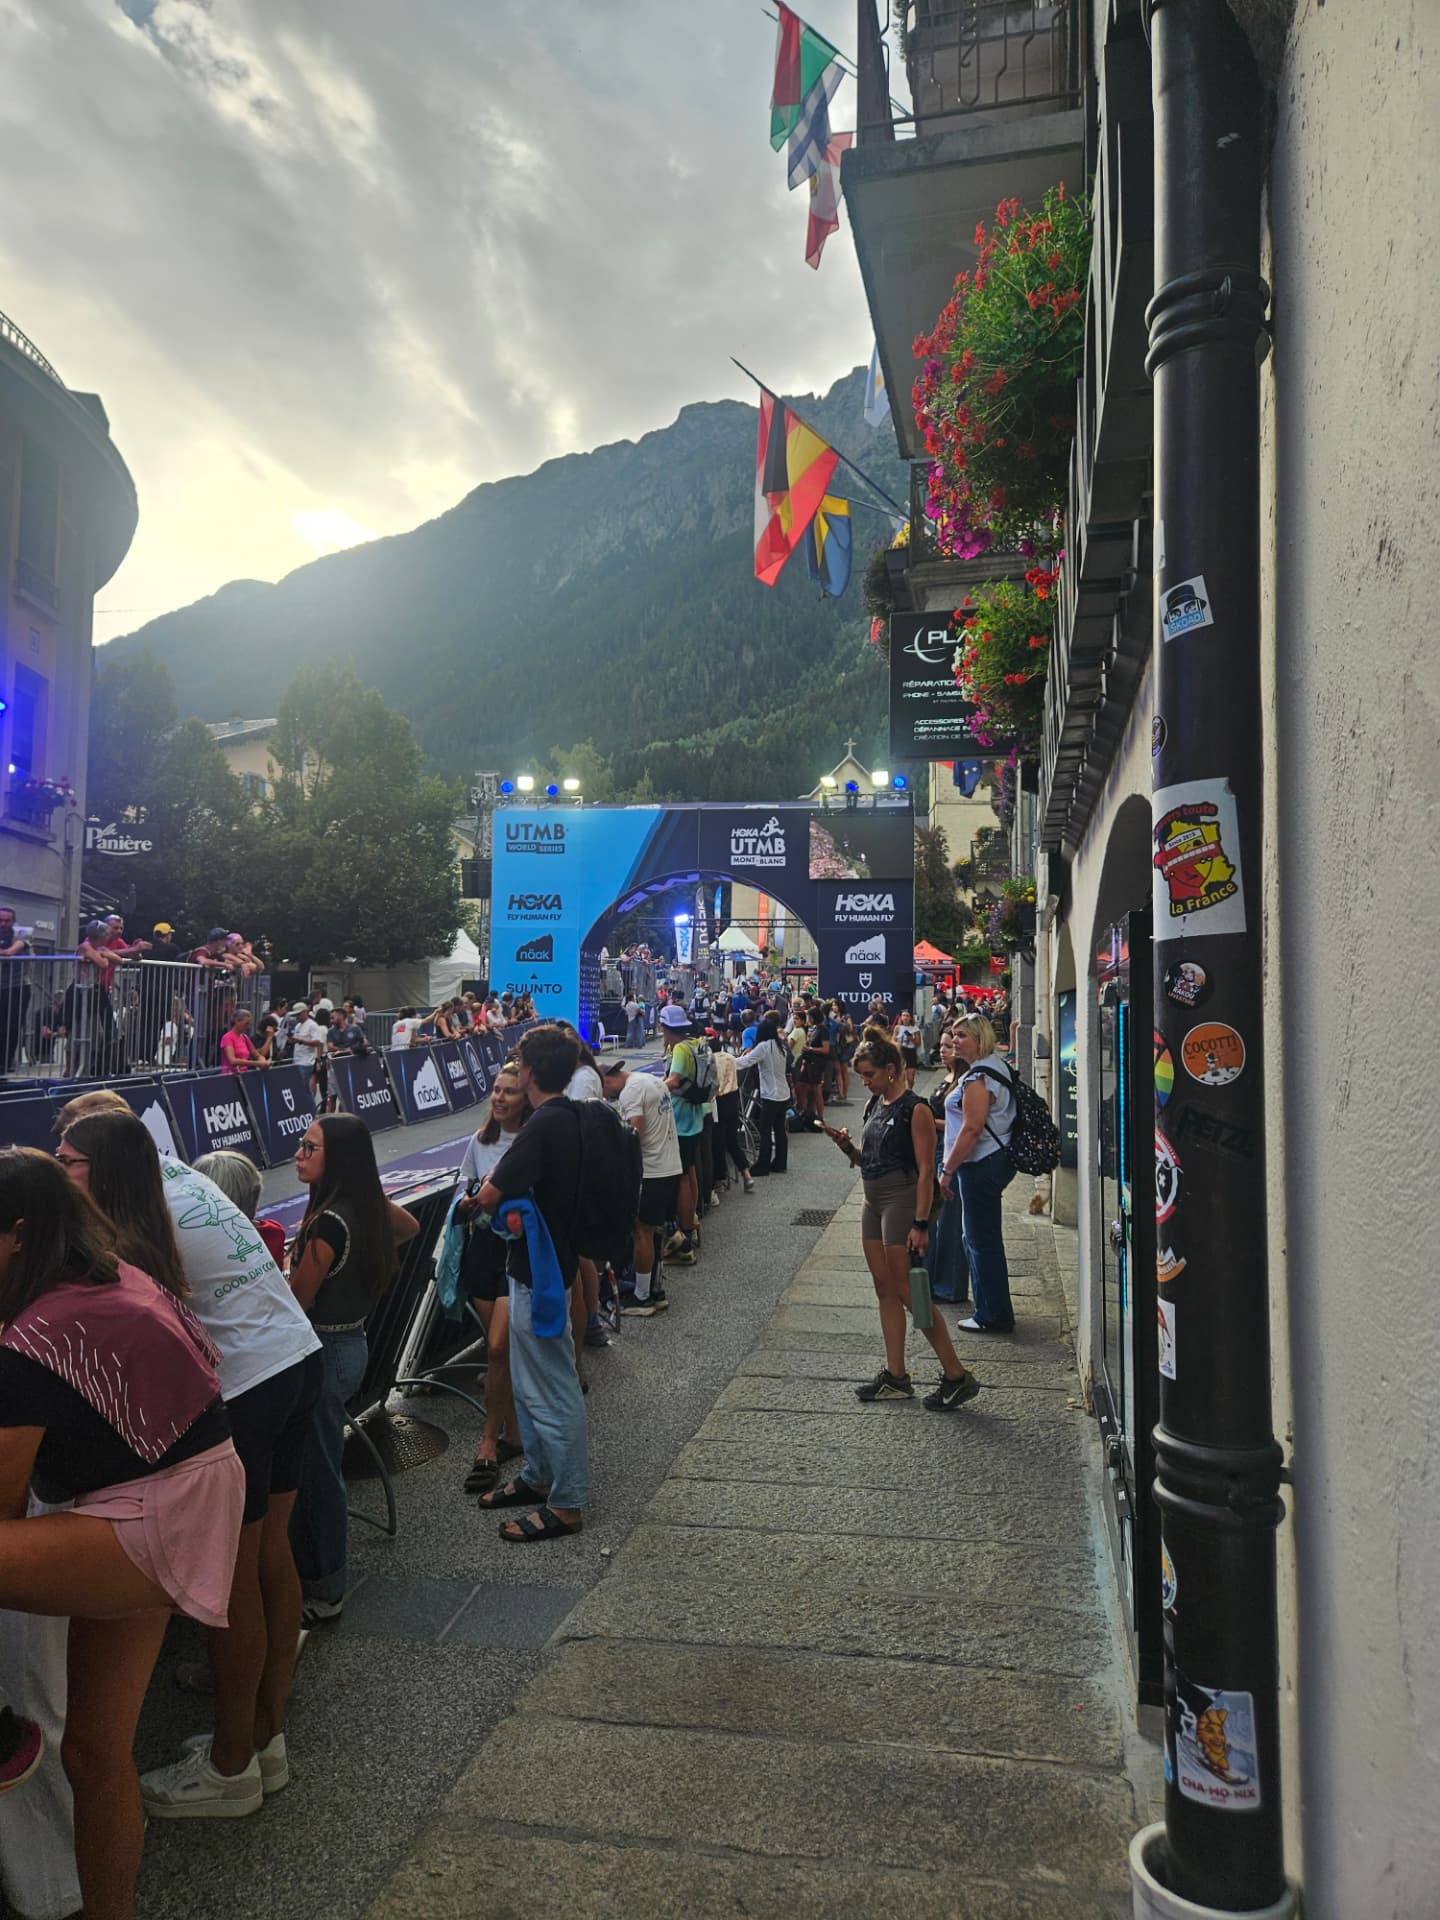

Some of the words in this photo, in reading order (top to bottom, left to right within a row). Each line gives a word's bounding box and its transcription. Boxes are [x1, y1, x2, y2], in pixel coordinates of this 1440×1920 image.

[928, 629, 975, 645] PLA
[902, 679, 957, 688] RÉPARATIO
[86, 824, 152, 852] Panière
[505, 823, 565, 841] UTMB
[731, 828, 759, 838] HOKA
[507, 843, 536, 851] WORLD
[538, 845, 563, 853] SERIES
[730, 838, 786, 855] UTMB
[507, 894, 563, 911] HOKA
[834, 893, 895, 912] HOKA
[1171, 902, 1183, 914] la
[1186, 881, 1236, 911] France
[507, 913, 520, 921] FLY
[520, 913, 549, 921] HUMAN
[549, 913, 562, 921] FLY
[834, 914, 848, 922] FLY
[848, 914, 880, 922] HUMAN
[880, 914, 894, 922] FLY
[519, 948, 550, 960] näak
[850, 949, 882, 961] näak
[506, 983, 562, 995] SUUNTO
[838, 992, 893, 1003] TUDOR
[356, 1088, 391, 1109] SUUNTO
[203, 1101, 248, 1134] HOKA
[211, 1137, 226, 1150] FLY
[225, 1132, 242, 1147] HUMAN
[214, 1275, 248, 1298] GOOD
